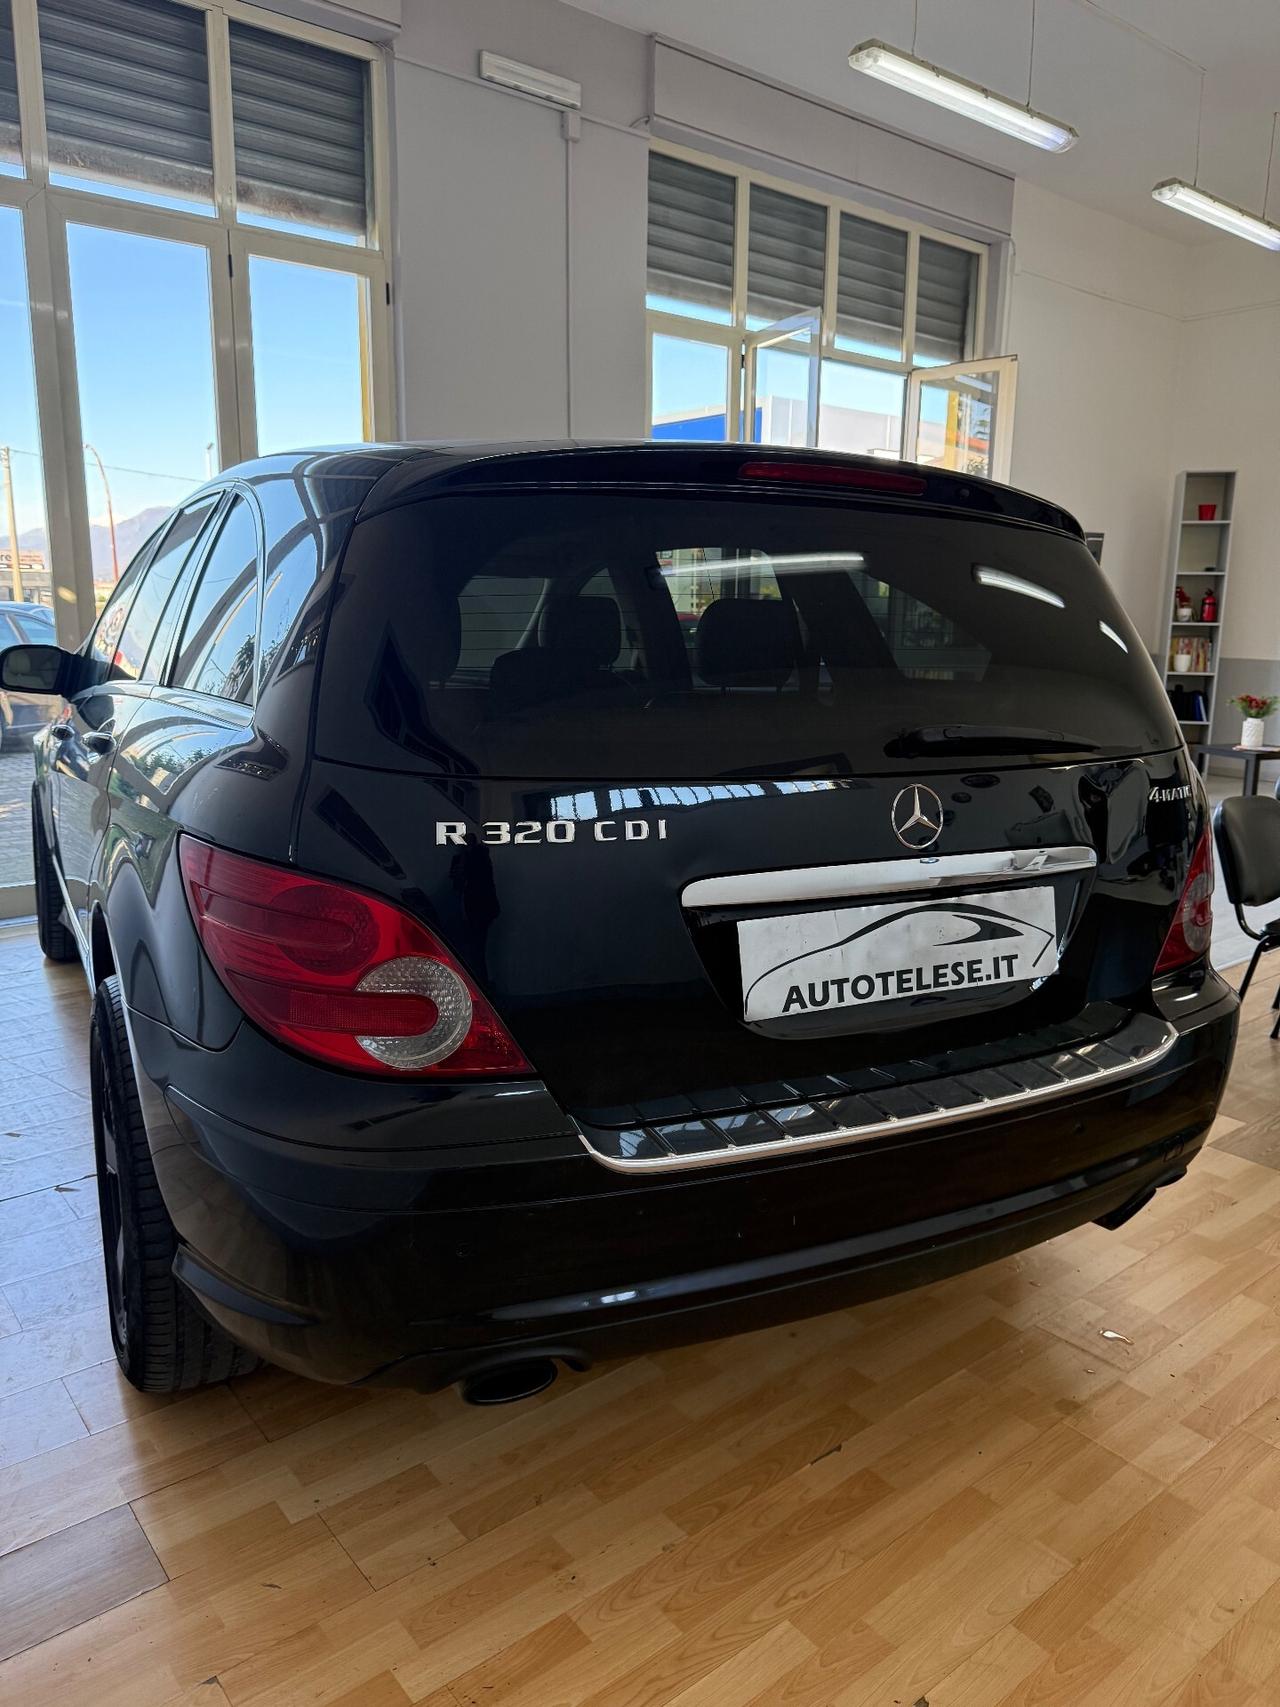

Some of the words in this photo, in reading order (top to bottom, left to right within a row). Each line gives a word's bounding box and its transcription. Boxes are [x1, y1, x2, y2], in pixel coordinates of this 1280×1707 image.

[436, 821, 467, 846] R
[482, 820, 576, 845] 320
[594, 819, 667, 841] CDI
[781, 954, 1019, 1013] AUTOTELESE.IT
